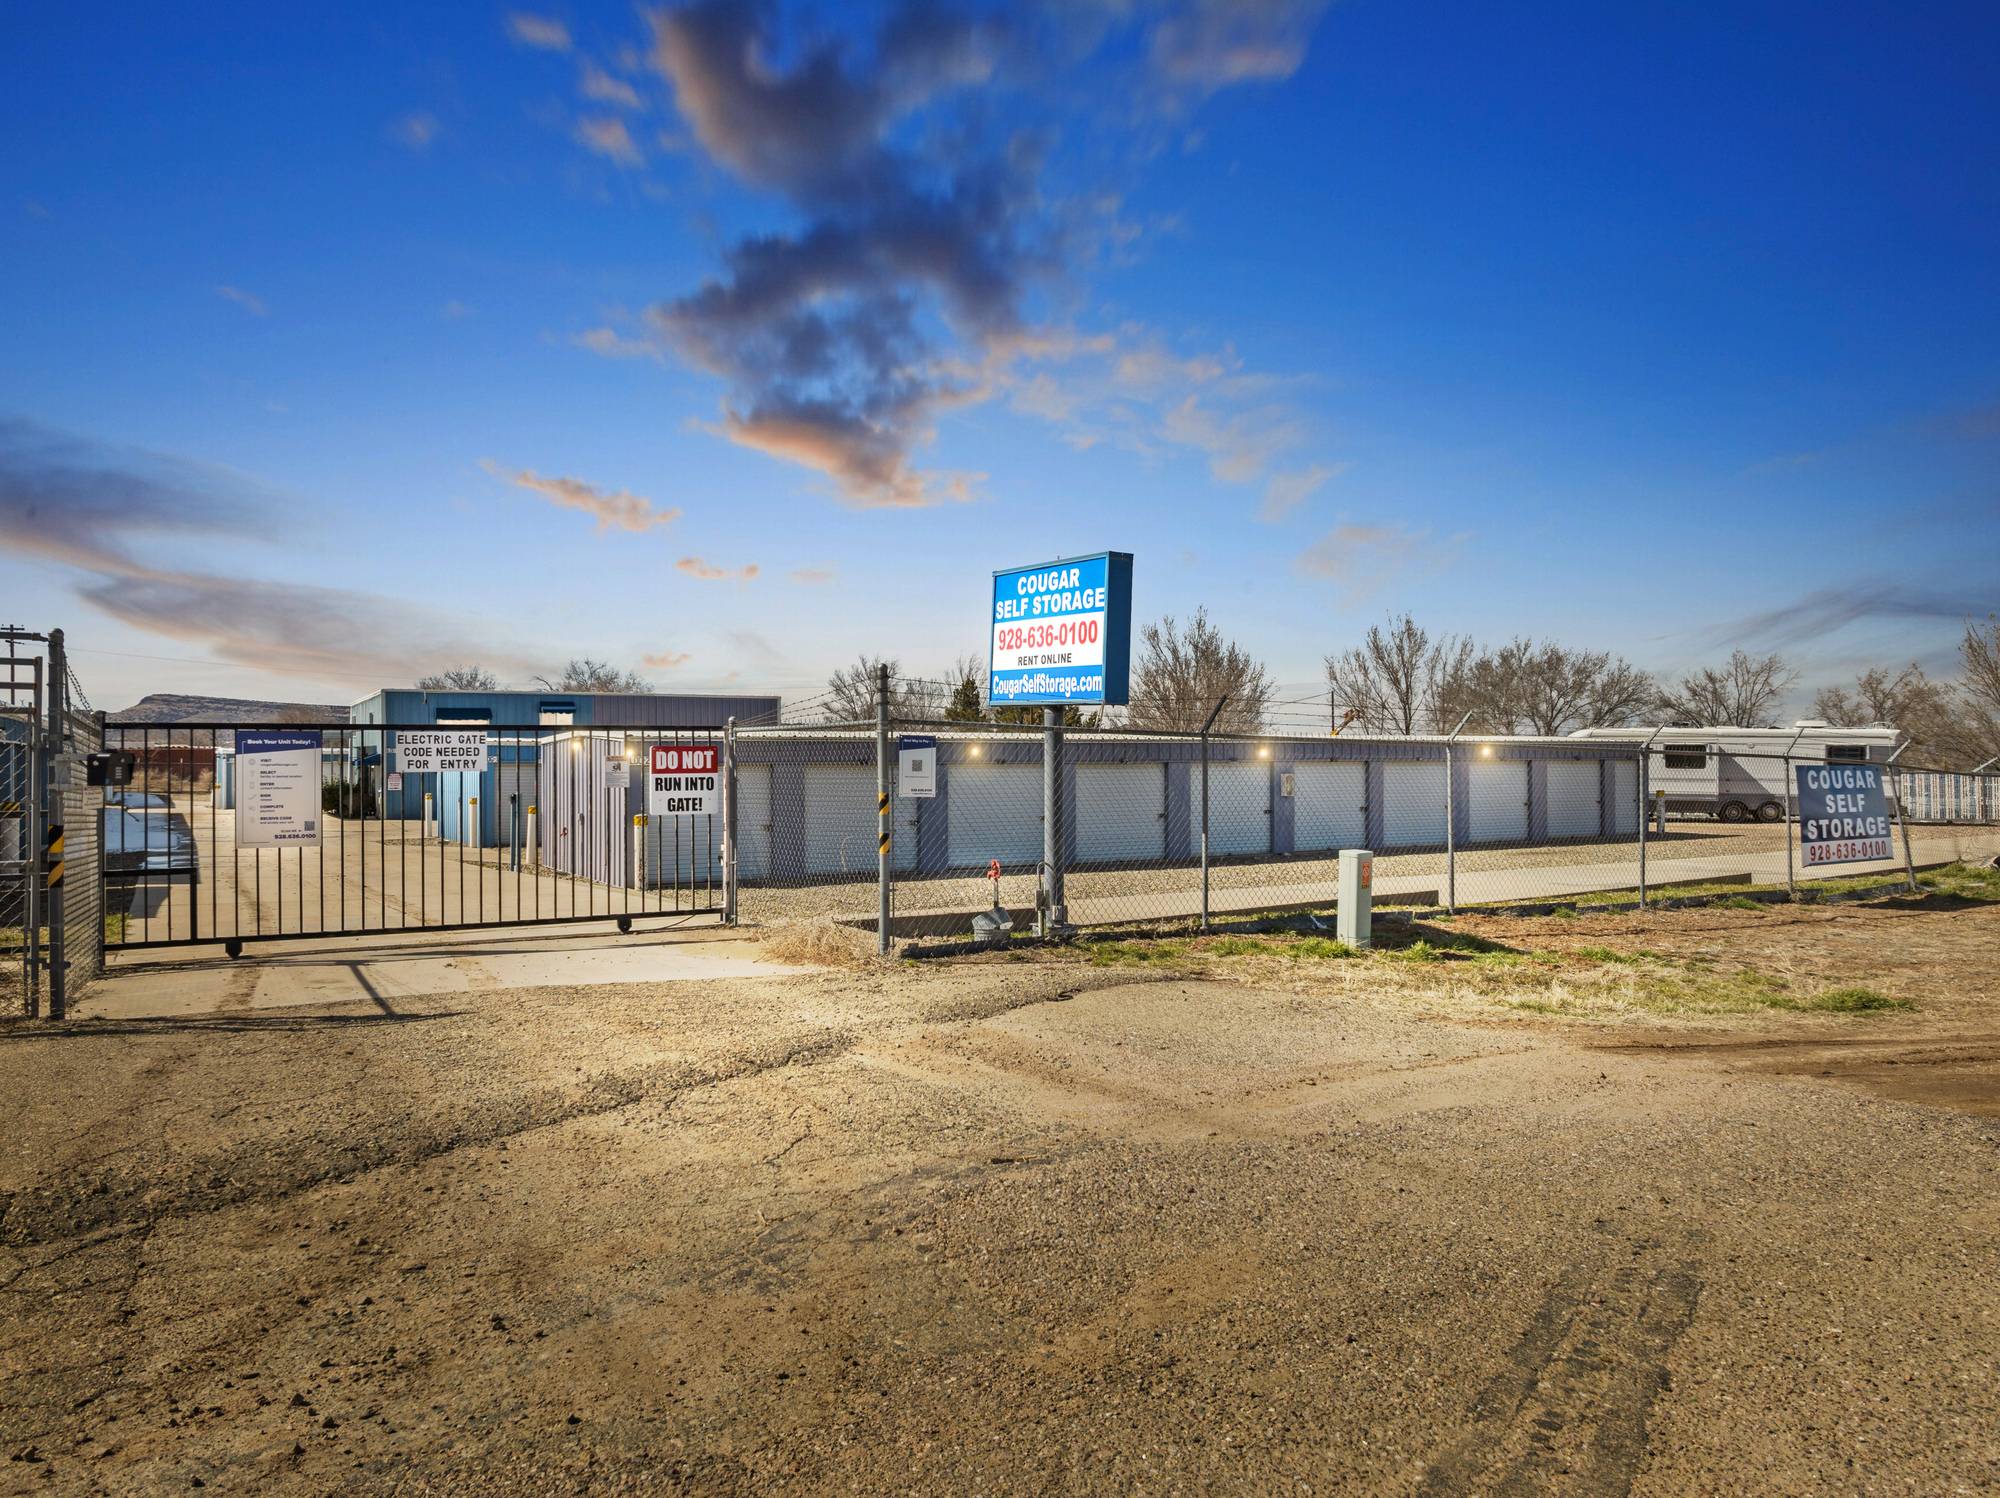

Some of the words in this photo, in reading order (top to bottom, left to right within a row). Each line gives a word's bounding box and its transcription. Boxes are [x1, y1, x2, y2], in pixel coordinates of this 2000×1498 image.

[1017, 568, 1080, 595] COUGAR
[995, 597, 1029, 620] SELF
[1032, 587, 1106, 615] STORAGE
[999, 620, 1098, 650] 928-636-0100
[1017, 655, 1038, 666] RENT
[1040, 652, 1072, 665] ONLINE
[993, 672, 1102, 698] CougarSelfStorage.com
[397, 734, 452, 745] ELECTRIC
[458, 734, 486, 744] GATE
[403, 747, 433, 757] CODE
[436, 747, 480, 757] NEEDED
[655, 751, 679, 770] DO
[682, 751, 714, 770] NOT
[407, 759, 429, 769] FOR
[440, 759, 477, 769] ENTRY
[655, 777, 681, 791] RUN
[685, 776, 715, 791] INTO
[1807, 770, 1877, 790] COUGAR
[667, 797, 703, 812] GATE!
[1825, 794, 1866, 814] SELF
[1807, 817, 1888, 840] STORAGE
[1809, 840, 1887, 862] 928-636-0100
